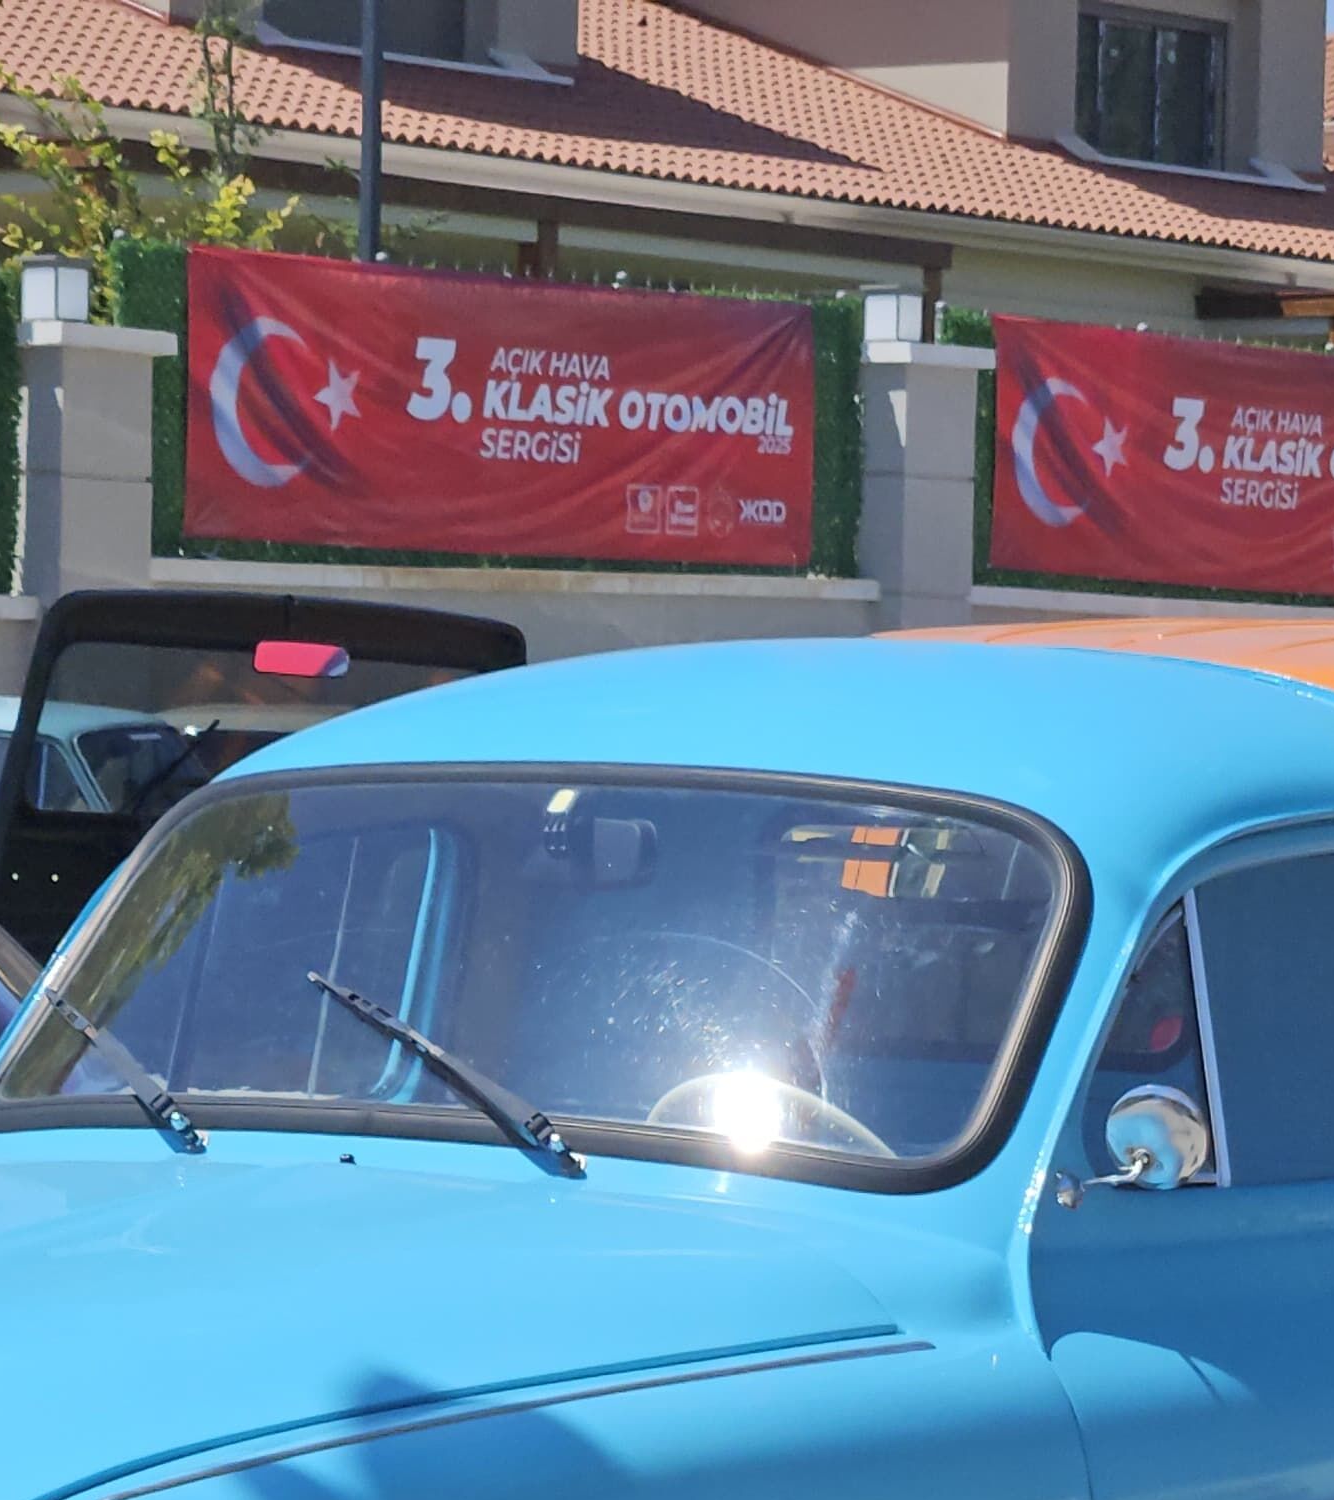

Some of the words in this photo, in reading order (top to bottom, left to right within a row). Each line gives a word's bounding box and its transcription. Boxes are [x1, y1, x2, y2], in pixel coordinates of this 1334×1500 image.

[406, 336, 473, 424] 3.
[490, 346, 547, 381] AÇIK
[548, 351, 610, 381] HAVA
[1163, 396, 1215, 474] 3.
[1231, 406, 1274, 434] AÇIK
[1275, 410, 1323, 437] HAVA
